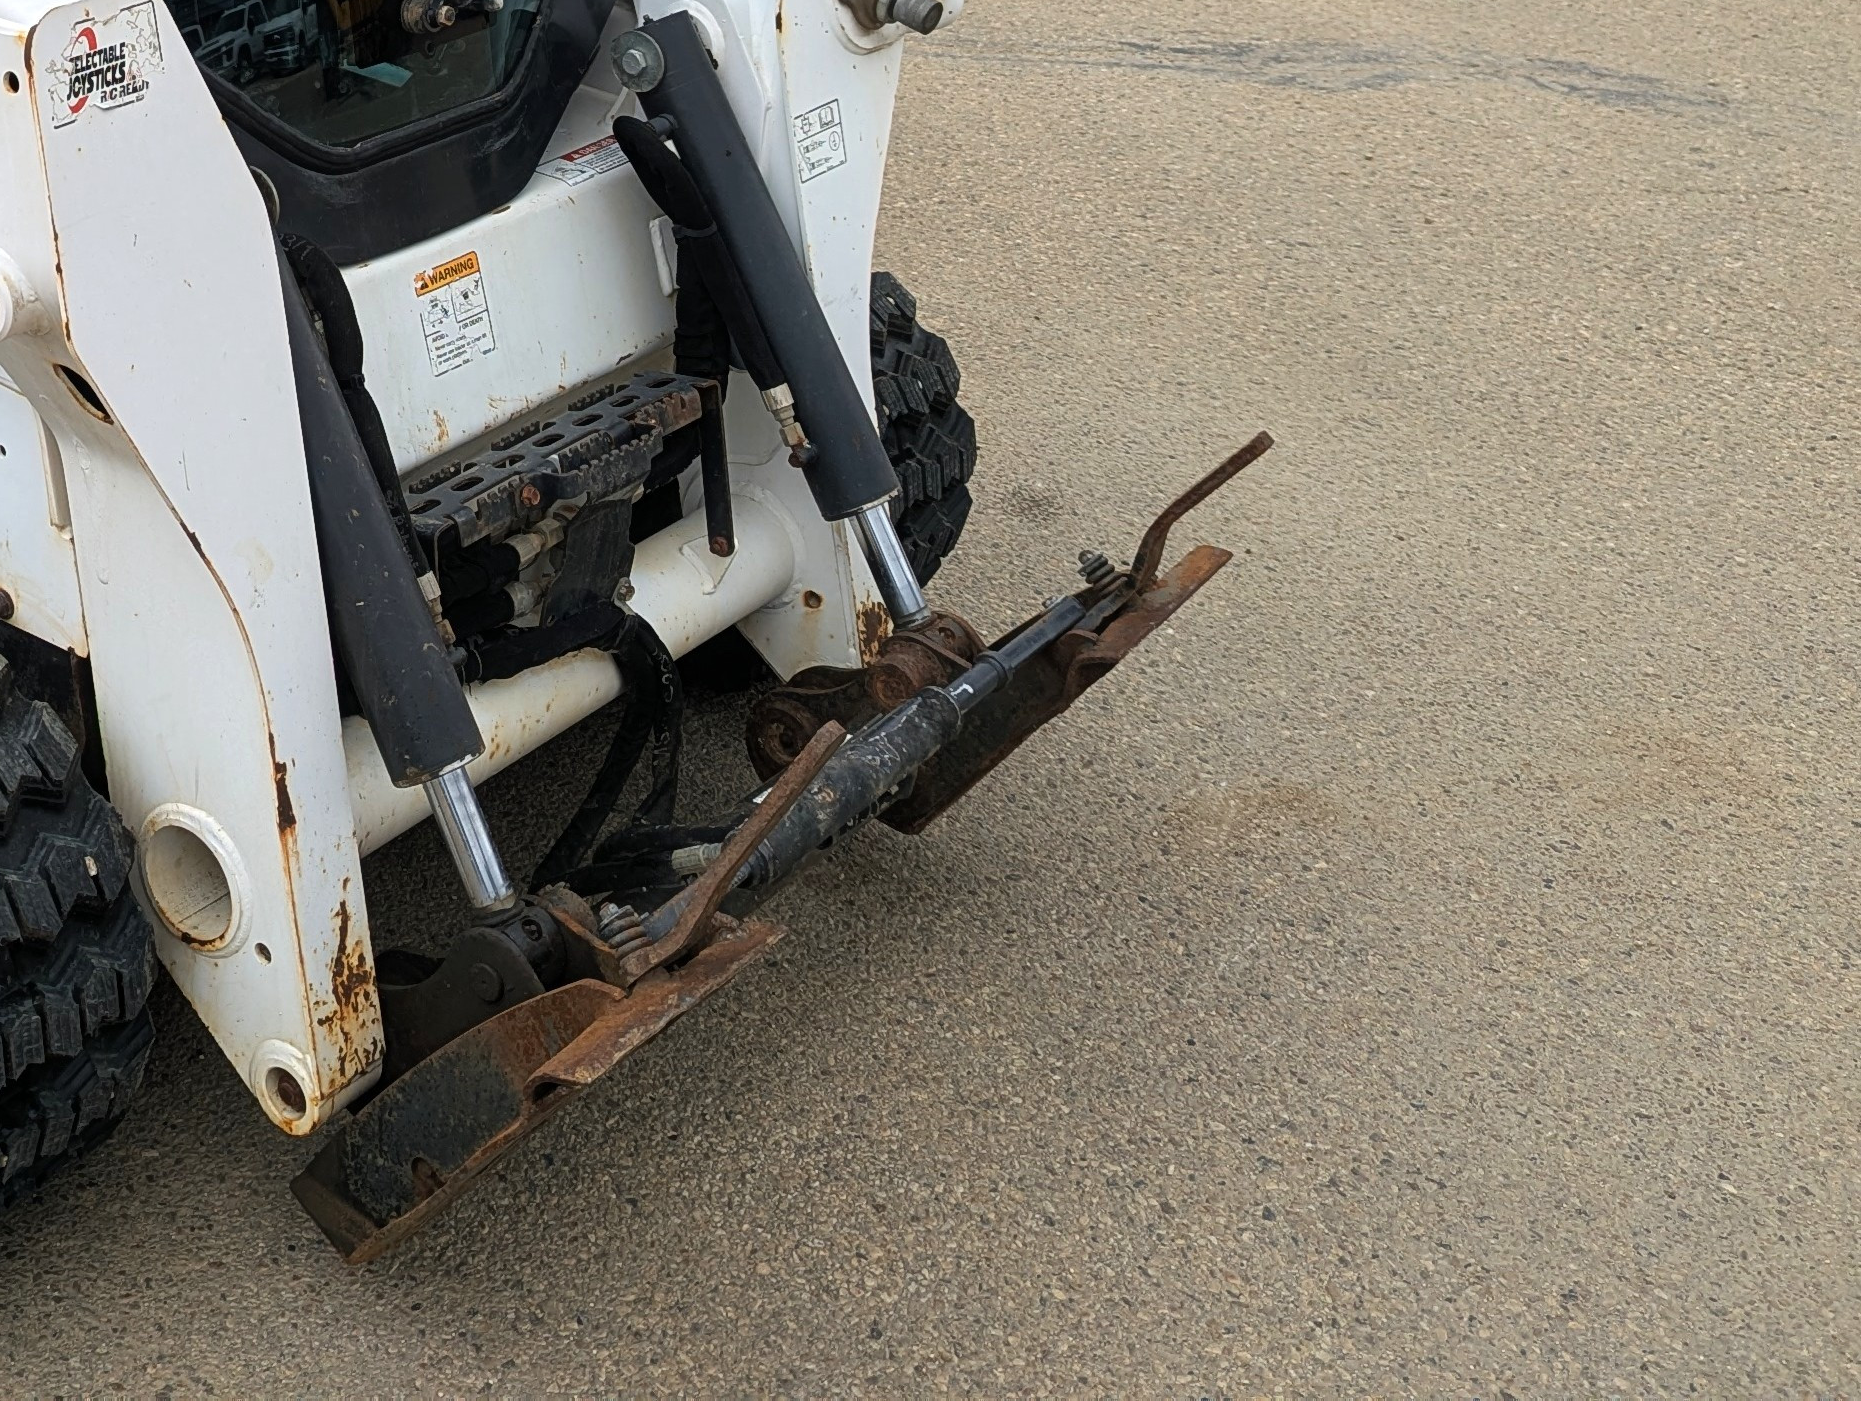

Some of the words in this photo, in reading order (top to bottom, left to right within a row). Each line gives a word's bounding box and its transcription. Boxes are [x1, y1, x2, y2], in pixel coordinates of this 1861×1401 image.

[69, 42, 126, 75] ELECTABLE
[67, 61, 126, 100] JOYSTICKS
[428, 258, 475, 286] WARNING
